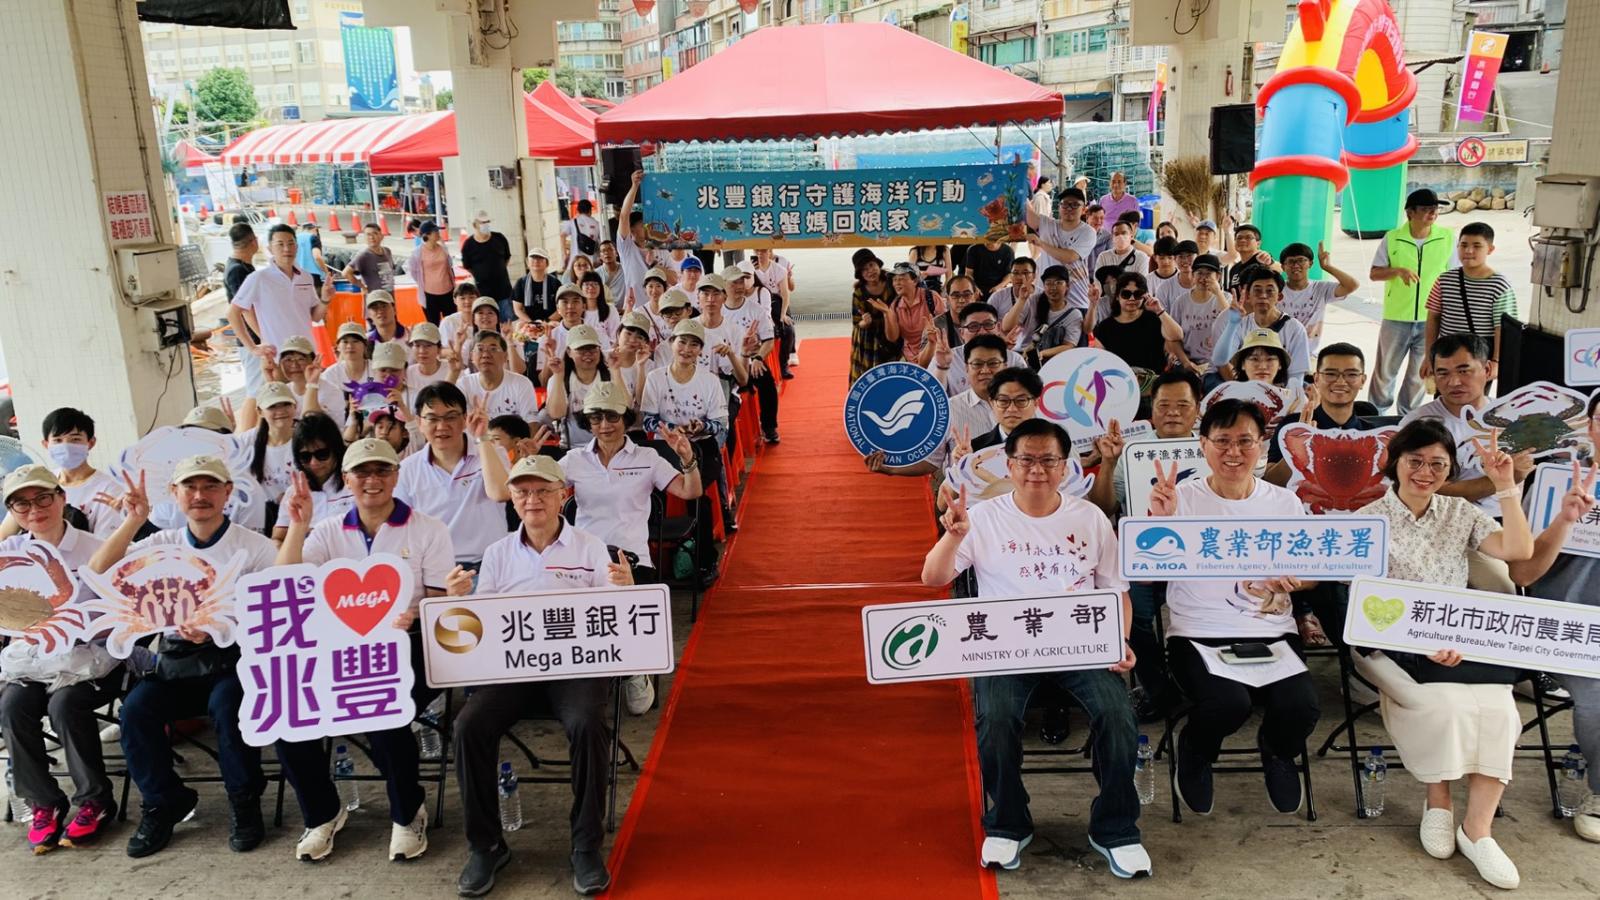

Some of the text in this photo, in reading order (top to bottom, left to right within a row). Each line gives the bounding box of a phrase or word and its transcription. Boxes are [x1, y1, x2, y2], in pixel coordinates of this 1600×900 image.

[697, 179, 966, 210] 兆豐銀行守護海洋行動
[751, 209, 911, 235] 送蟹媽回娘家
[847, 405, 866, 449] NATIONAL
[907, 441, 936, 462] OCEAN
[929, 383, 948, 437] UNIVERSITY
[1196, 526, 1376, 561] 農業部漁業署
[1196, 562, 1235, 570] Fisheries
[1272, 562, 1309, 571] Ministry
[1311, 562, 1321, 570] of
[1323, 562, 1374, 571] Agriculture
[247, 577, 318, 655] 我
[501, 603, 661, 643] 兆豐銀行
[960, 603, 1107, 642] 農業部
[1410, 599, 1600, 646] 新北市政府農業局
[505, 644, 623, 672] Mega Bank
[961, 643, 1110, 663] MINISTRY OF AGRICULTURE
[1407, 628, 1454, 642] Agriculture
[1508, 641, 1533, 653] Taipei
[1535, 645, 1551, 657] City
[249, 641, 403, 734] 兆豐
